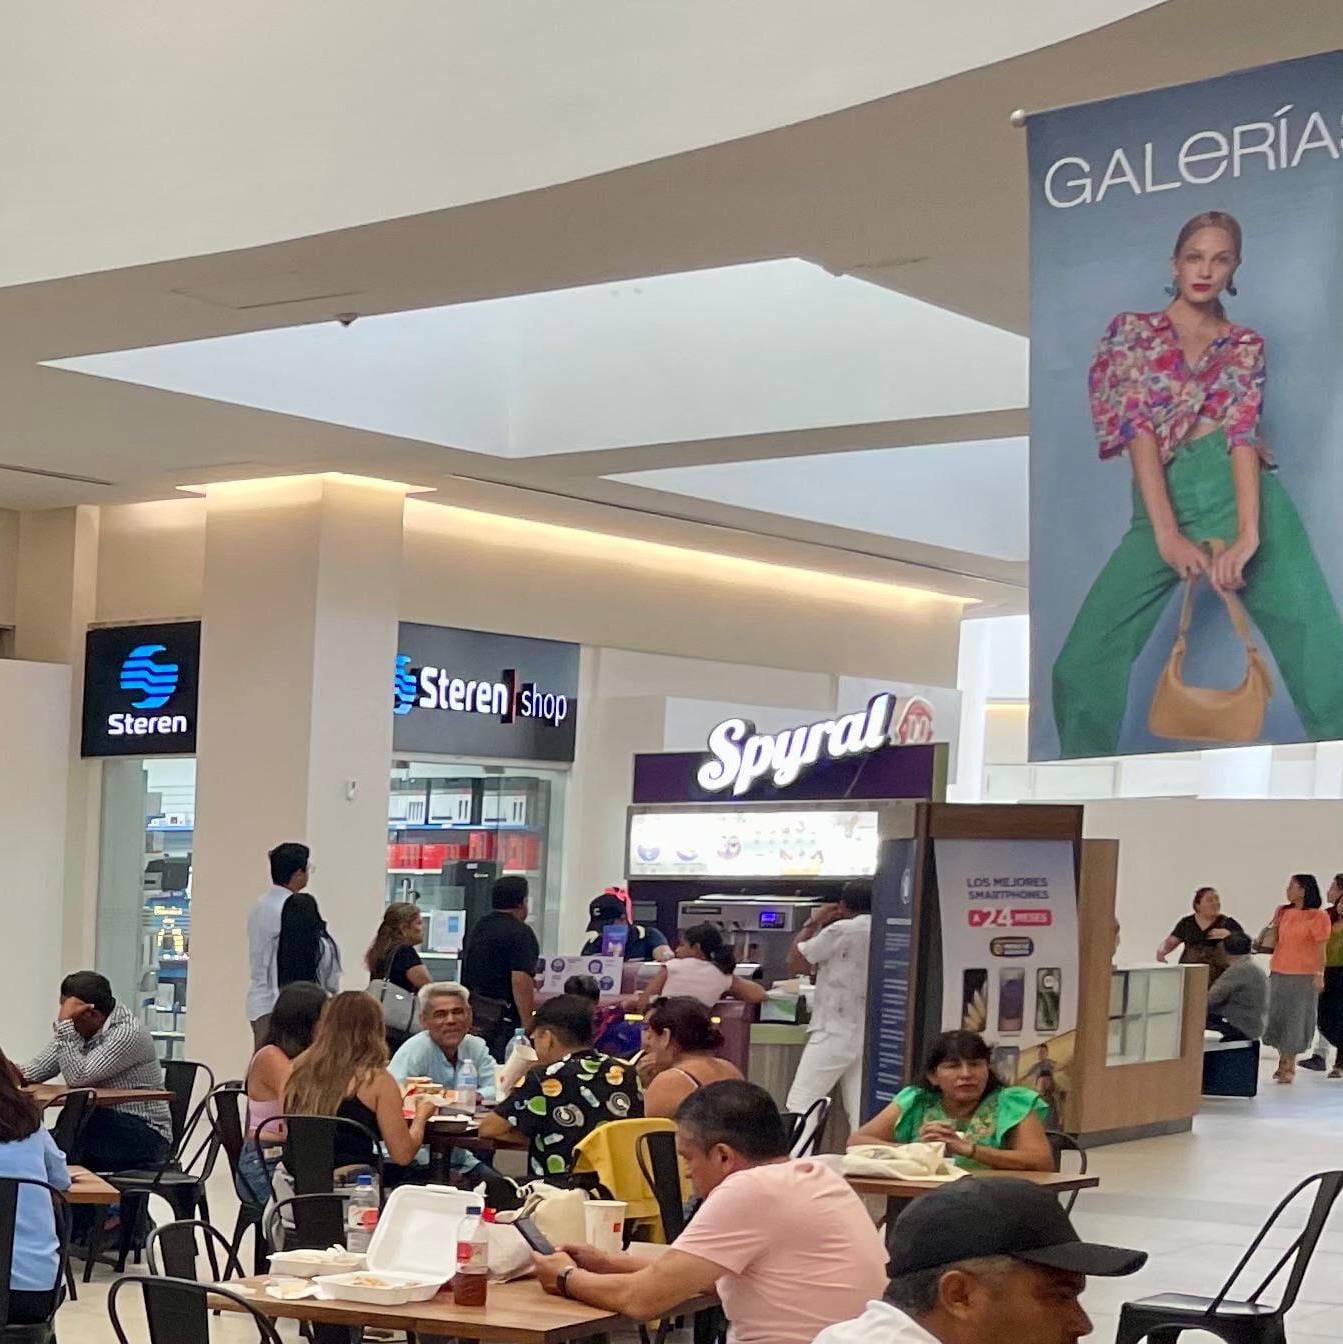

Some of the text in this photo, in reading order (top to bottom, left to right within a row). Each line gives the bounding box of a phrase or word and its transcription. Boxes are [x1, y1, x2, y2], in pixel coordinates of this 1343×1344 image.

[419, 666, 568, 727] Steren shop
[107, 713, 188, 736] Steren
[696, 691, 894, 796] Spyral
[967, 877, 1049, 888] LOS MEJORES
[968, 890, 1050, 900] SMARTPHONES
[982, 907, 1014, 927] 24
